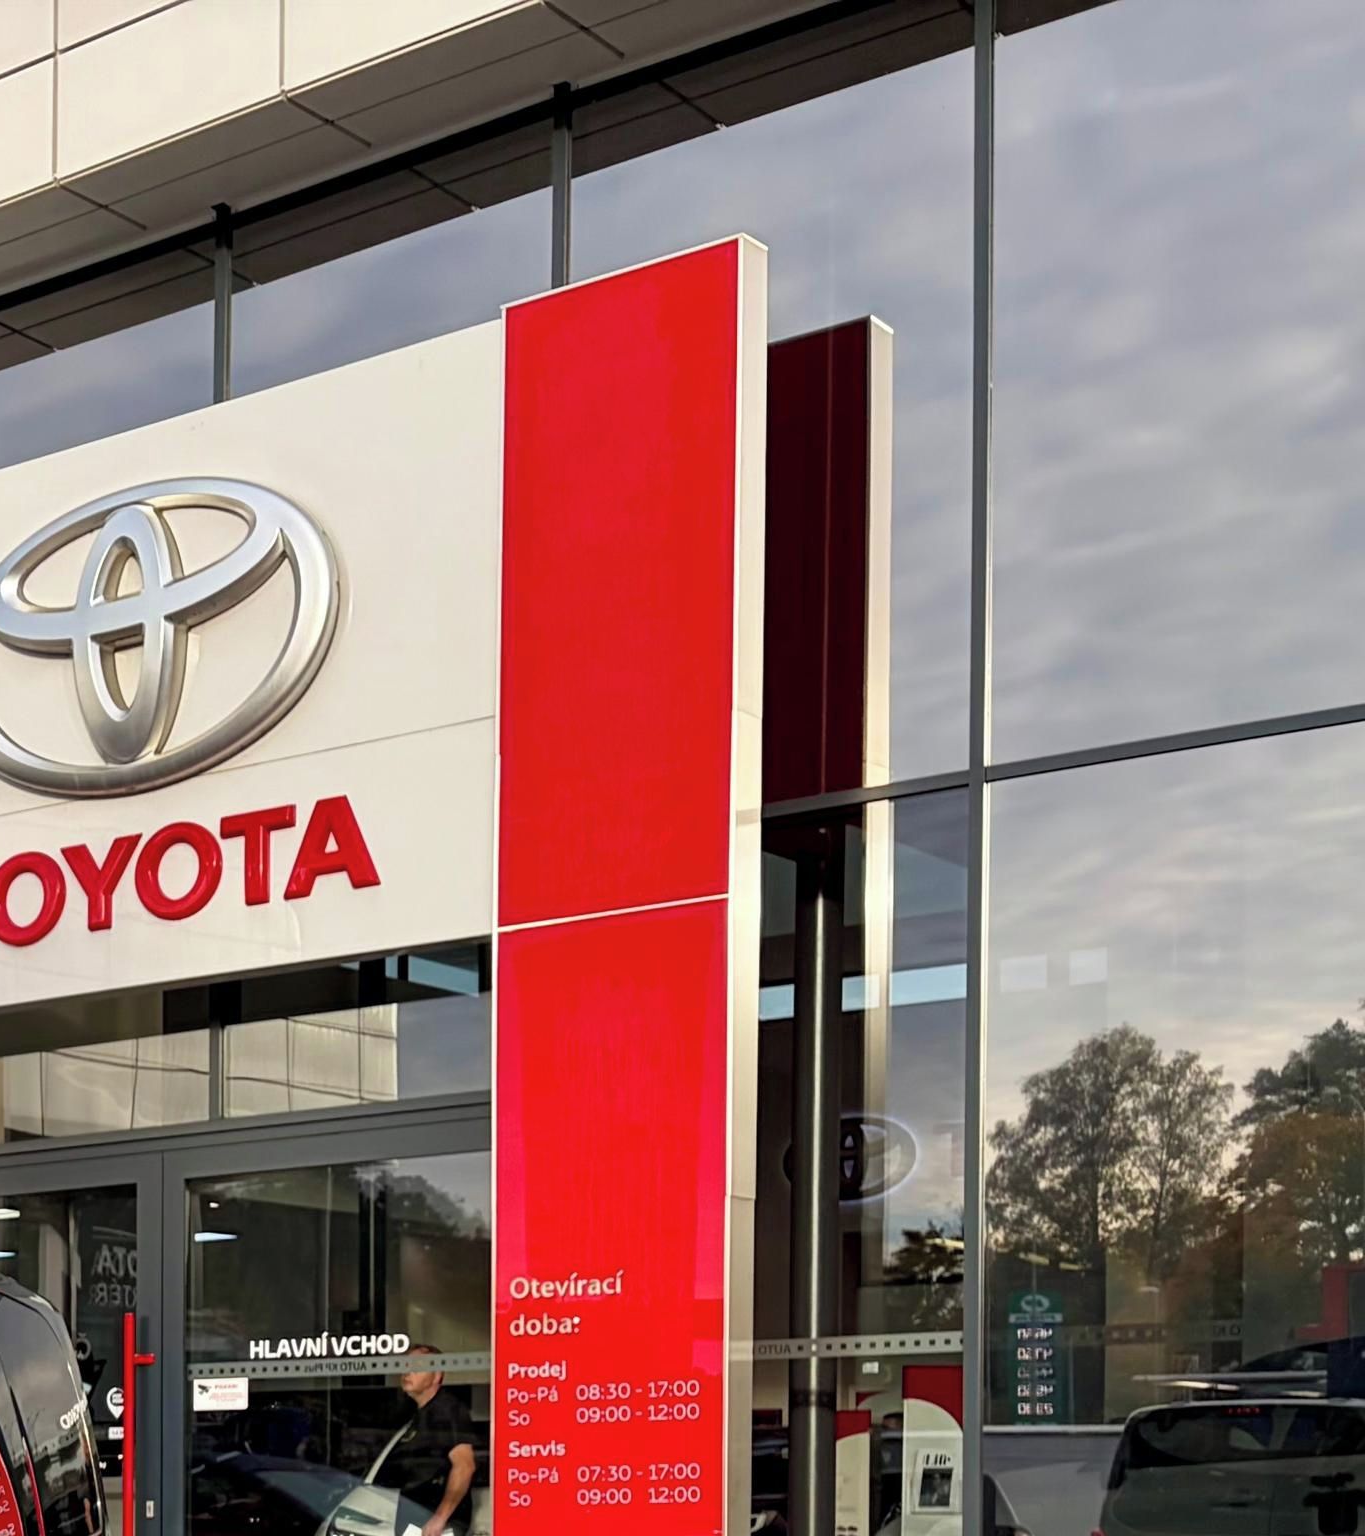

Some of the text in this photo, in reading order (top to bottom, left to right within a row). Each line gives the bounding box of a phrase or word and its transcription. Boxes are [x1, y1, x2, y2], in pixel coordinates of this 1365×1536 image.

[509, 1270, 624, 1301] Otevírací
[510, 1314, 580, 1336] doba:
[249, 1332, 410, 1359] HLAVNÍ VCHOD
[508, 1360, 567, 1381] Prodej
[507, 1386, 558, 1405] Po-Pá
[576, 1383, 631, 1400] 08:30
[648, 1379, 700, 1399] 17:00
[509, 1410, 530, 1427] So
[576, 1406, 631, 1424] 09:00
[647, 1403, 700, 1421] 12:00
[508, 1441, 566, 1459] Servis
[508, 1467, 559, 1484] Po-Pá
[577, 1465, 631, 1482] 07:30
[648, 1462, 700, 1480] 17:00
[509, 1486, 700, 1507] So 09:00 12:00
